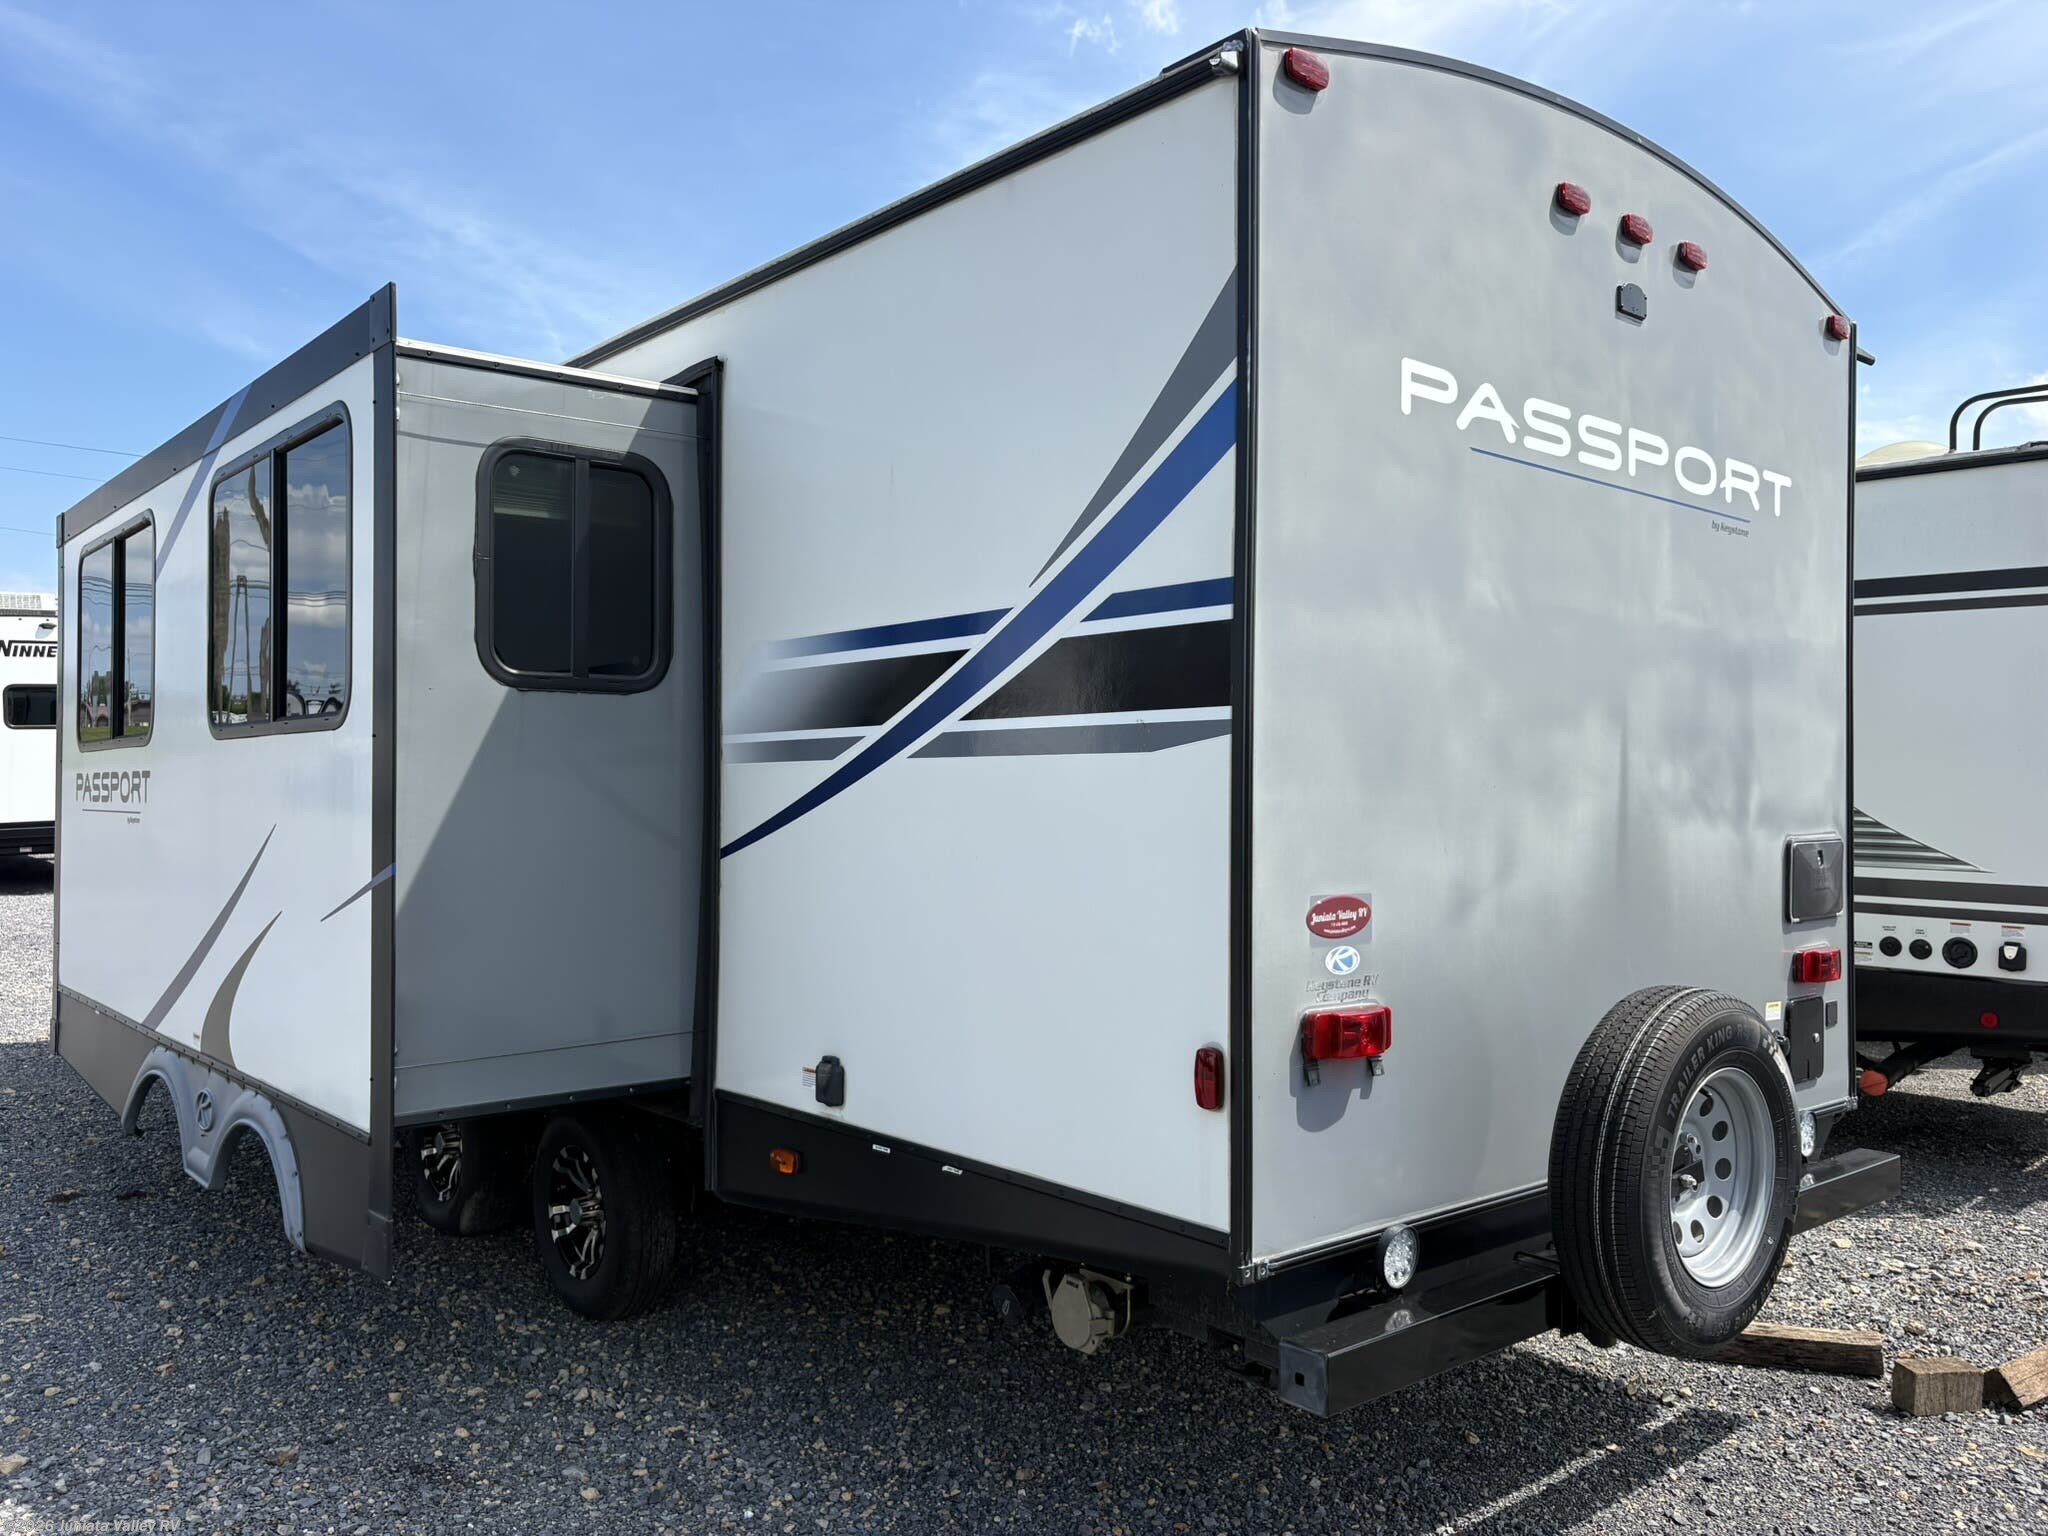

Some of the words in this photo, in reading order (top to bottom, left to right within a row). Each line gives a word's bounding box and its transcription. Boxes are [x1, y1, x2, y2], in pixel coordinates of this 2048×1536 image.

[1401, 357, 1792, 517] PASSPORT
[1711, 519, 1720, 532] by
[75, 770, 151, 804] PASSPORT
[1310, 912, 1336, 926] Juniata
[1337, 909, 1357, 921] Valley
[1358, 907, 1368, 917] RV
[1666, 1046, 1705, 1119] TRAILER
[1706, 1025, 1732, 1053] KING
